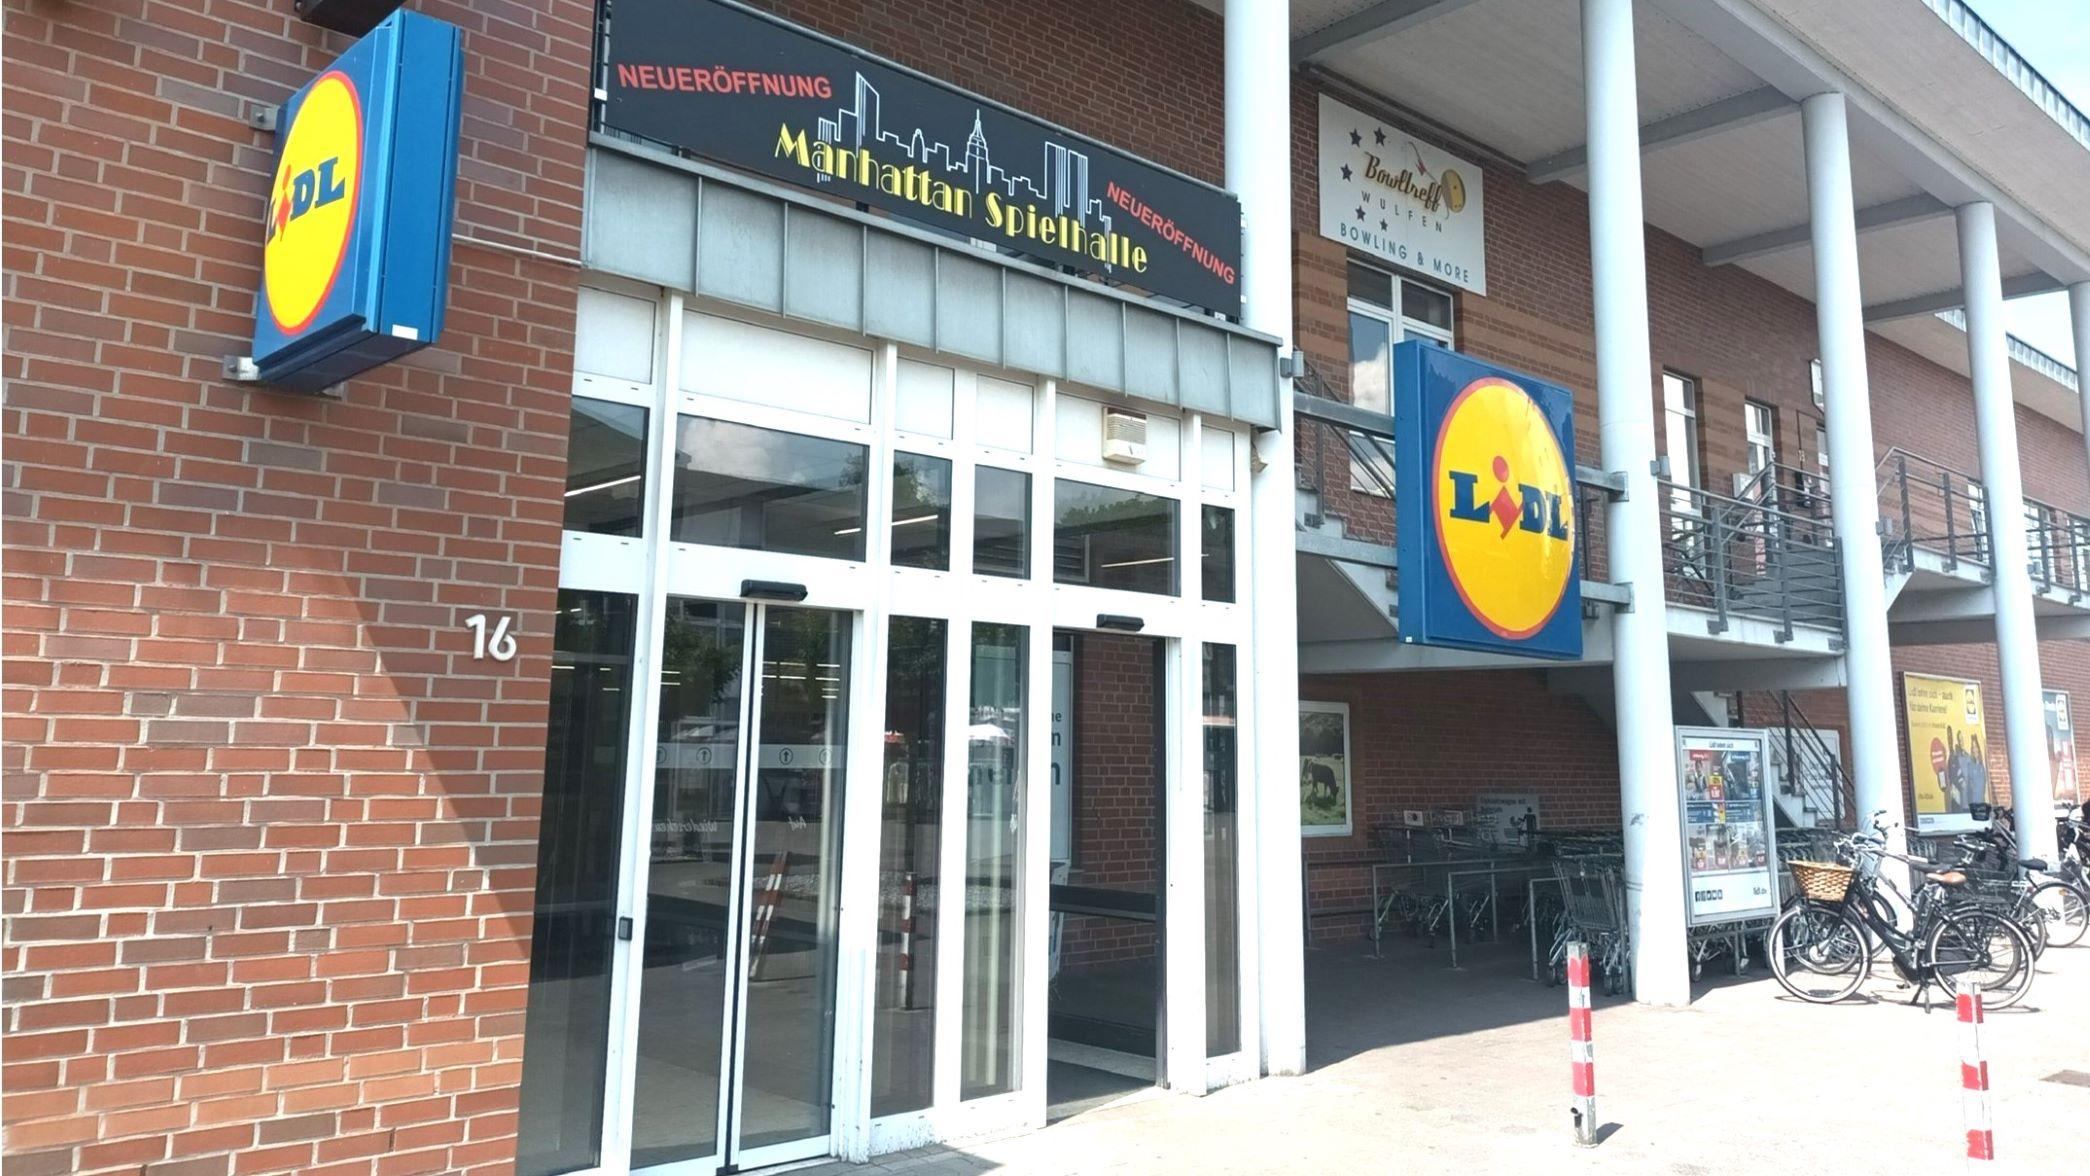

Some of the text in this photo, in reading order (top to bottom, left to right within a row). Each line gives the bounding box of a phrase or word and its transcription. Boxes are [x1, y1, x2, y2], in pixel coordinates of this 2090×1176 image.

[617, 64, 833, 99] NEUERÖFFNUNG
[774, 122, 1148, 274] Manhattan Spielhalle
[1363, 151, 1443, 213] Bowltreff
[1106, 180, 1236, 286] NEUERÖFFNUNG
[1340, 221, 1470, 284] BOWLING & MORE
[464, 613, 517, 661] 16
